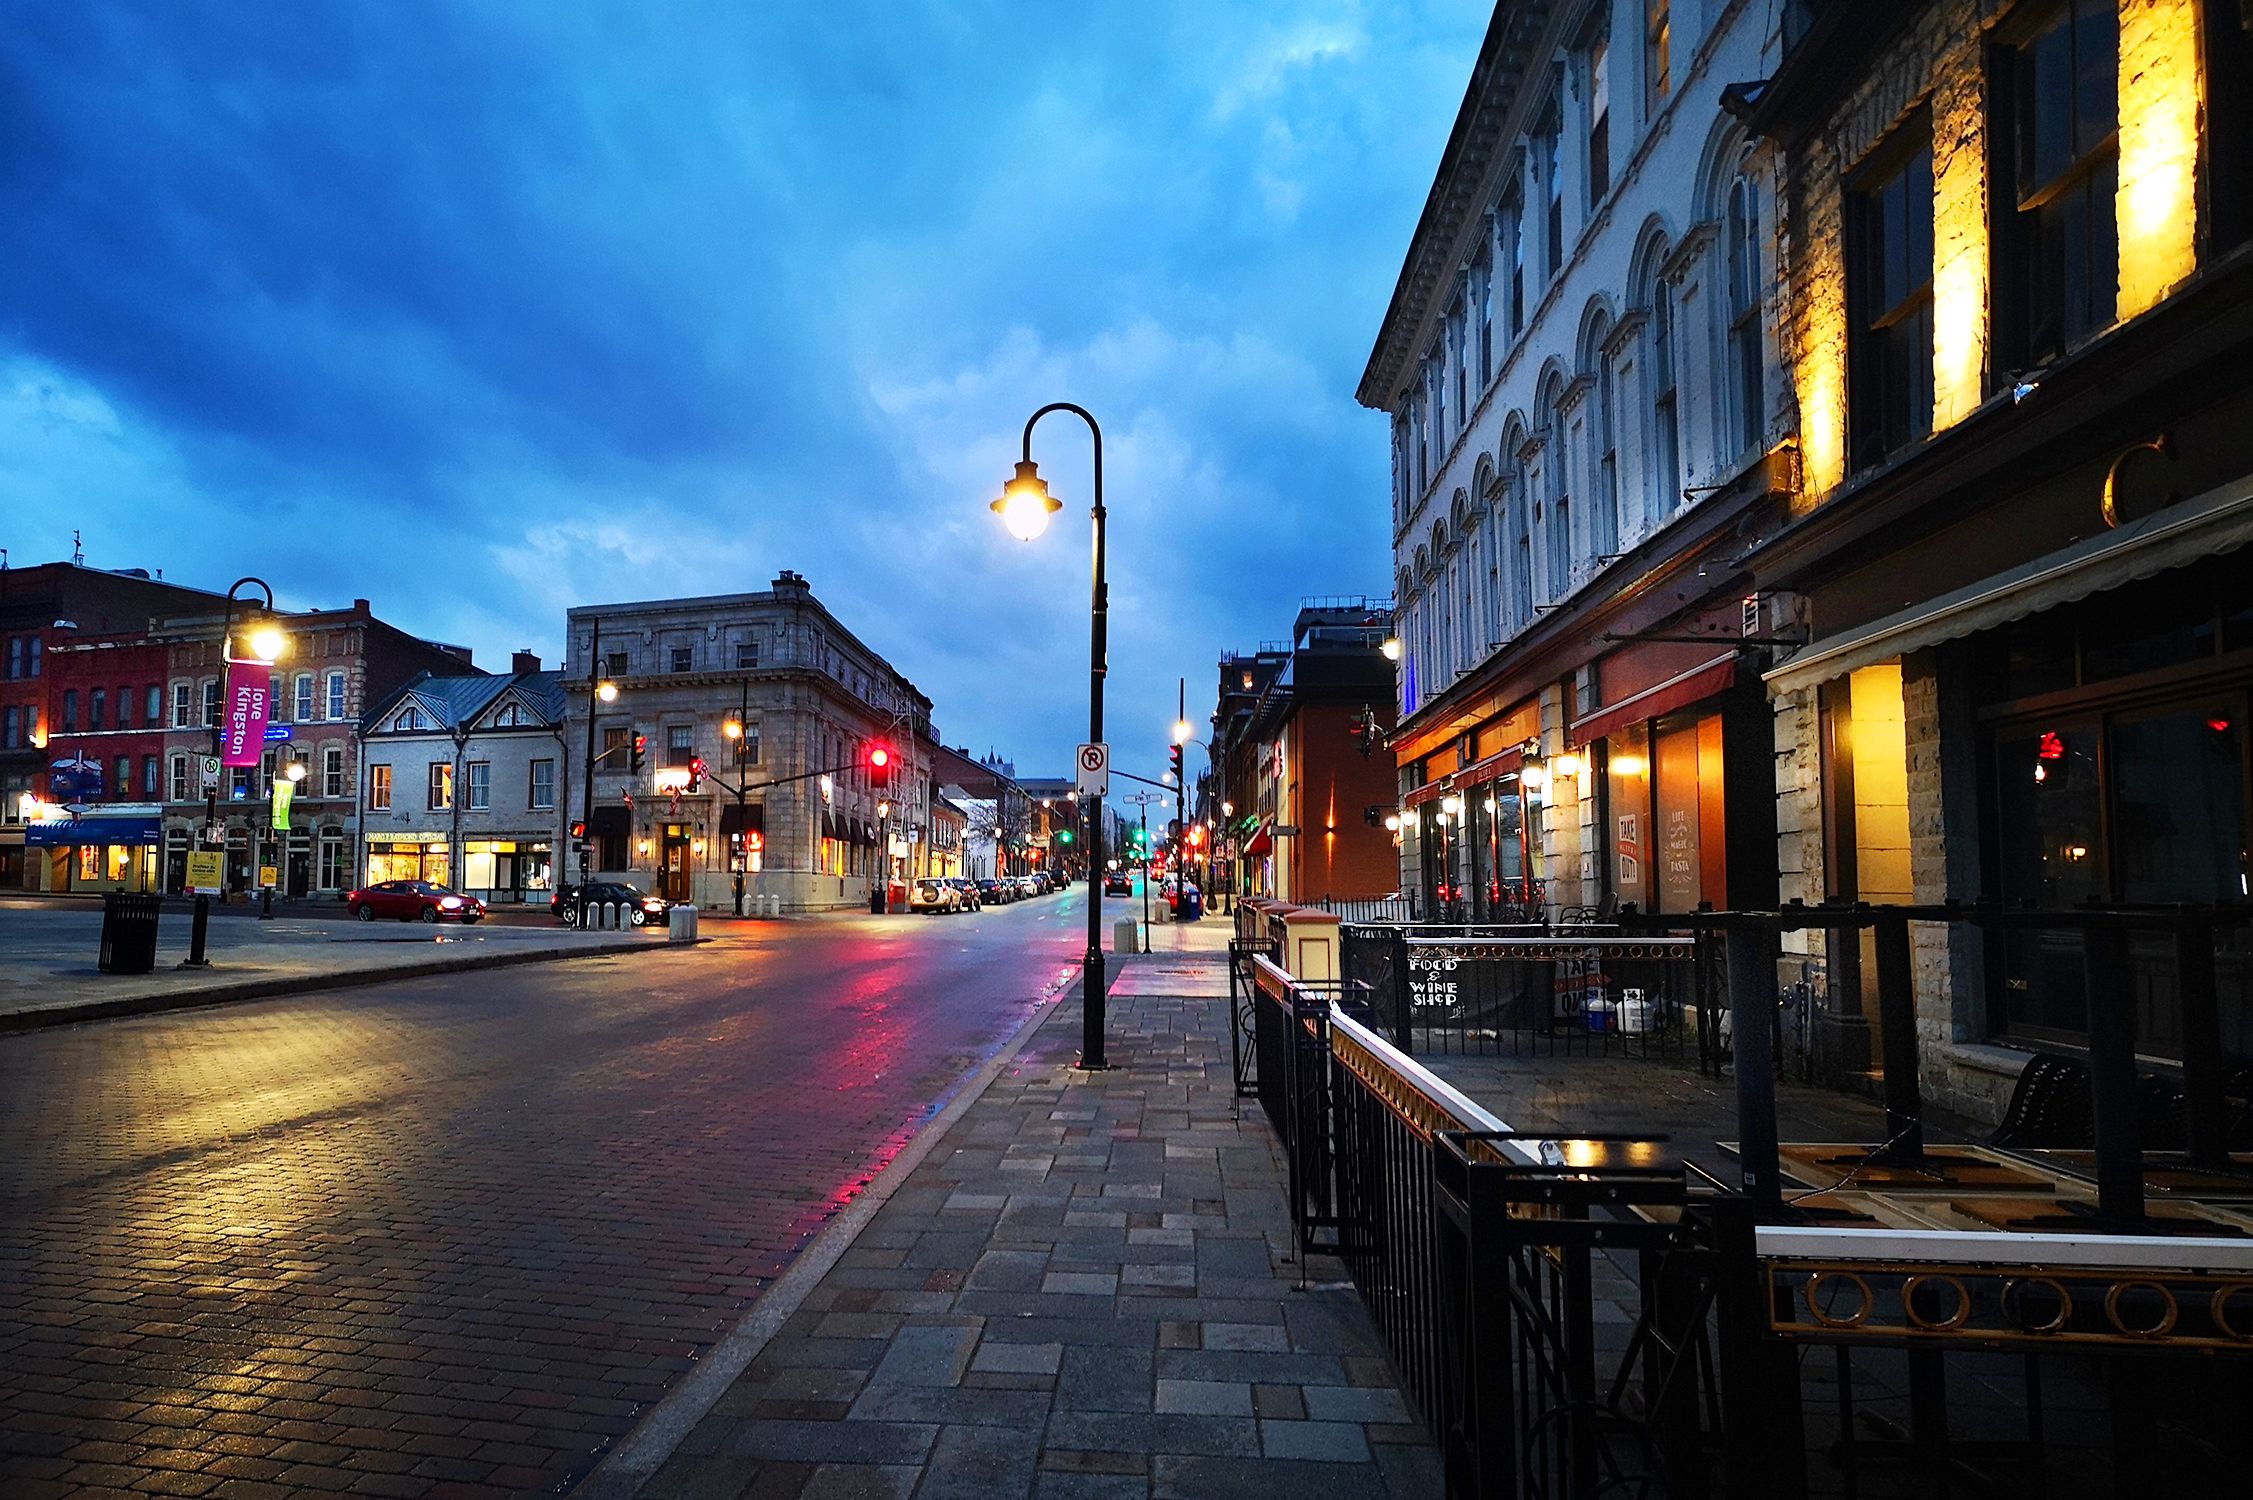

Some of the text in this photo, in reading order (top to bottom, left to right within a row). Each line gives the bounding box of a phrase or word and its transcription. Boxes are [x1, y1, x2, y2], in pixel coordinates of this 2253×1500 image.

[251, 687, 266, 720] love
[232, 686, 252, 755] Kingston
[1620, 819, 1635, 841] TAKE
[1670, 860, 1690, 872] PASTA
[1409, 960, 1458, 971] FOOD
[1426, 970, 1442, 982] &
[1408, 981, 1458, 994] WINE
[1413, 993, 1457, 1006] SHOP
